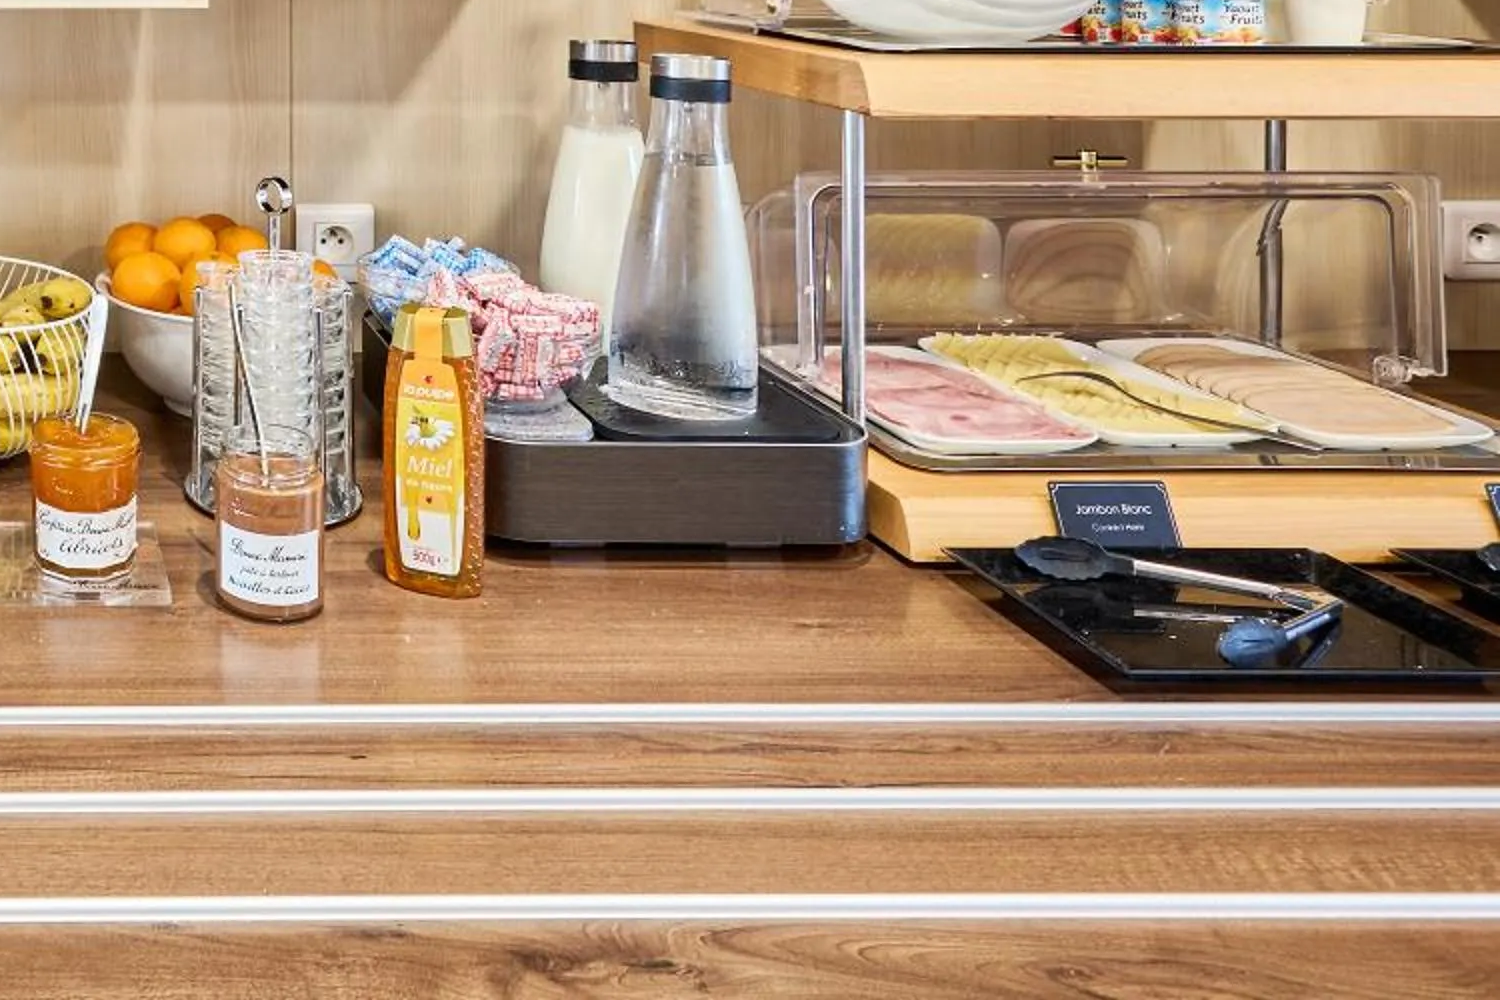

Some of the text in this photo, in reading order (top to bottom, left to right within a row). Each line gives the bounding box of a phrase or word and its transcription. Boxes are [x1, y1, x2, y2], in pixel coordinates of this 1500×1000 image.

[407, 456, 453, 478] Miel
[1075, 503, 1153, 515] Jambon Blanc
